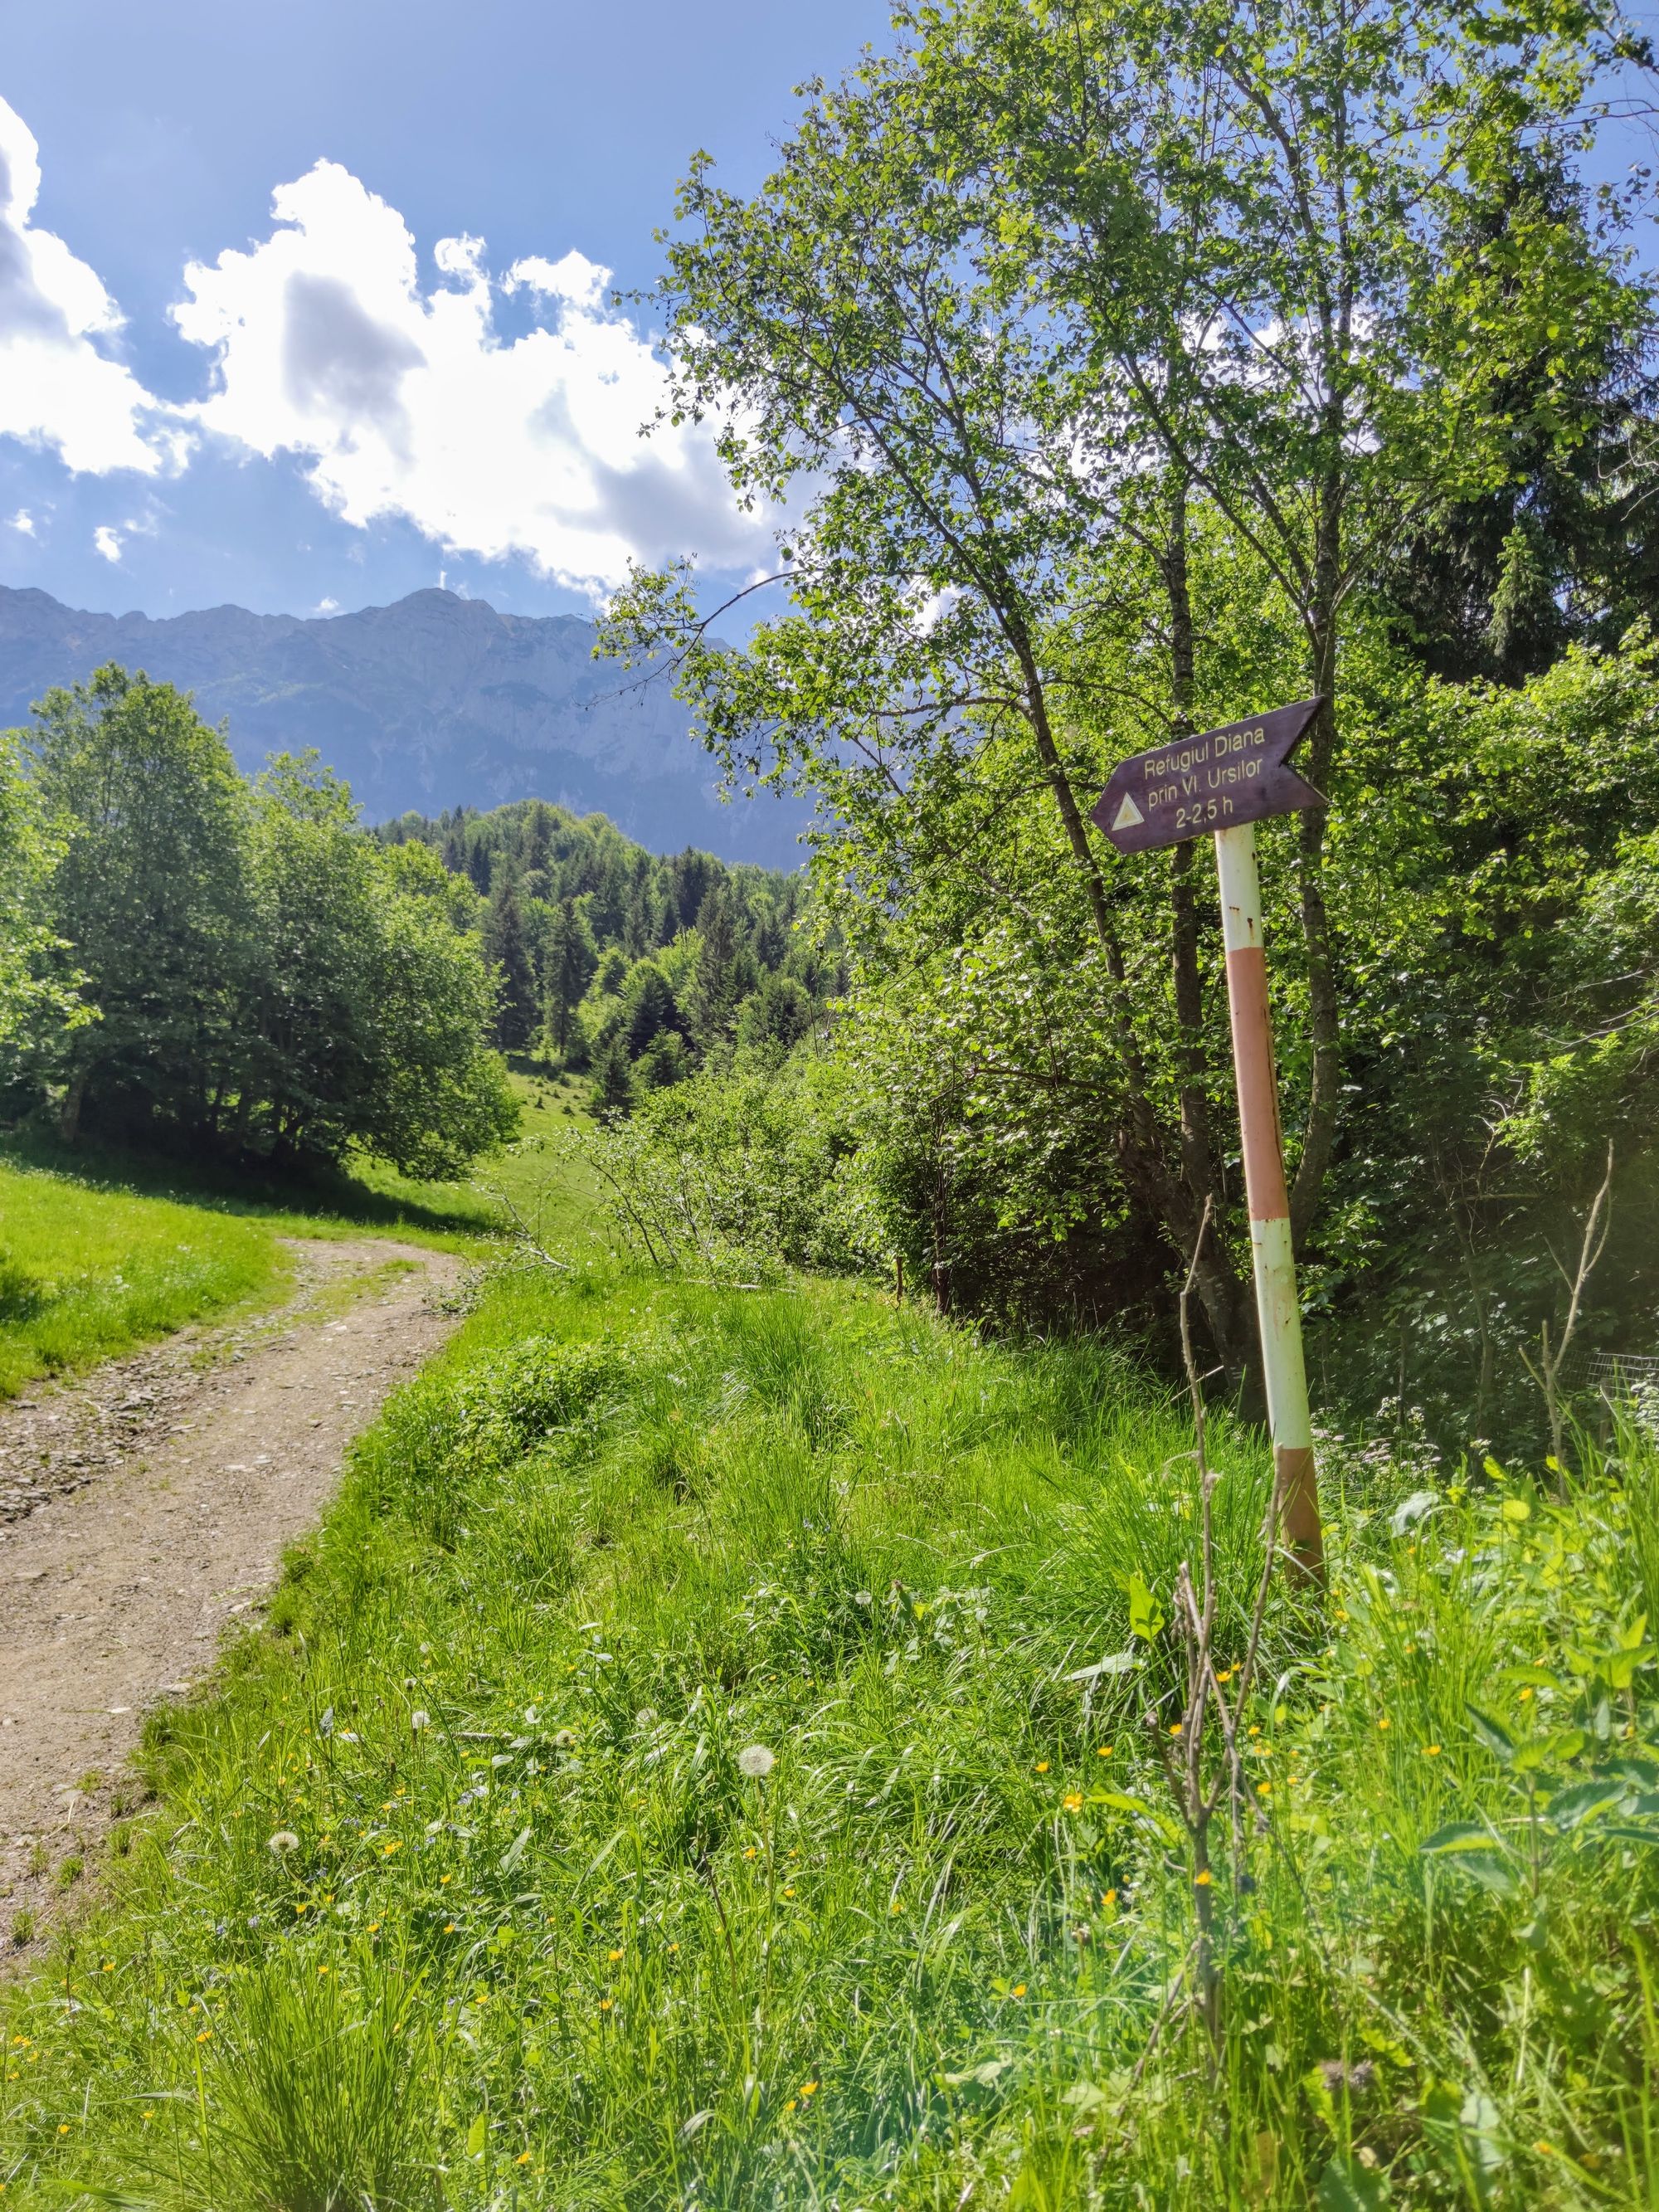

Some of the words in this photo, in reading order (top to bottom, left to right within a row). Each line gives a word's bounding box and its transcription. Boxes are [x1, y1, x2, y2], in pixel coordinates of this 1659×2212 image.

[1145, 742, 1209, 780] Refugiul
[1215, 728, 1265, 757] Diana
[1148, 784, 1177, 811] prin
[1208, 758, 1262, 789] Ursilor
[1176, 799, 1217, 828] 2-2,5
[1223, 797, 1233, 814] h
